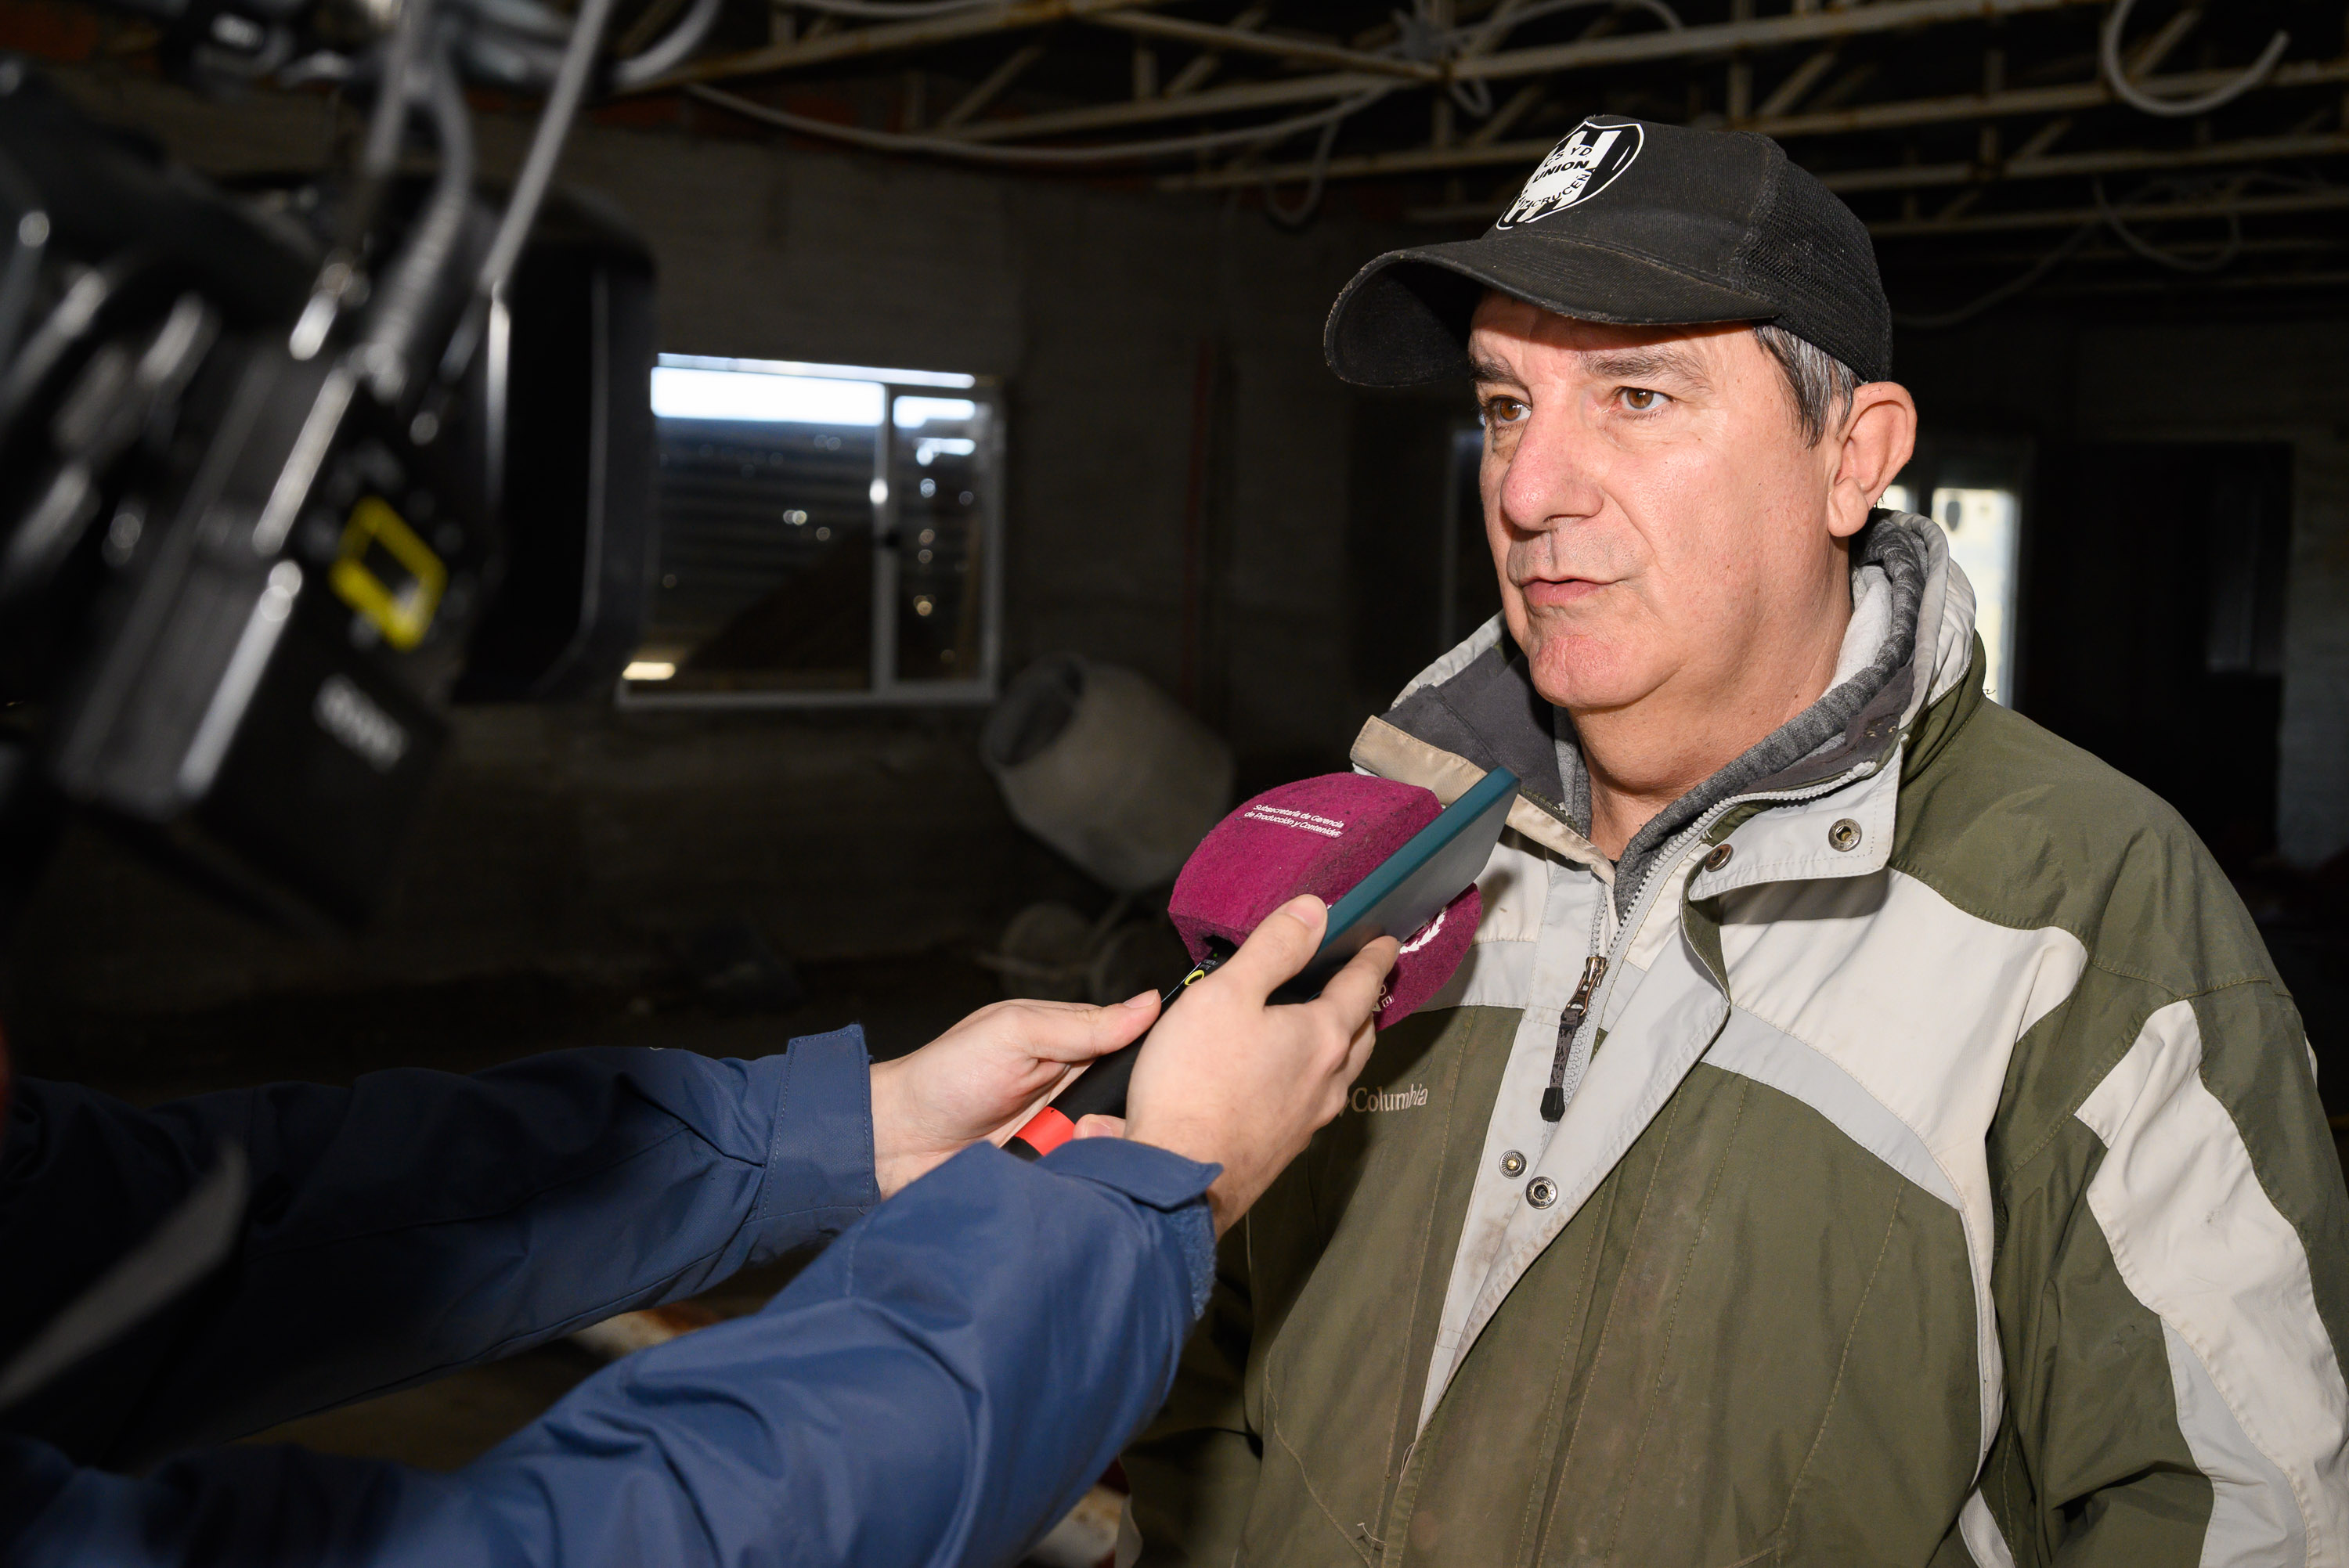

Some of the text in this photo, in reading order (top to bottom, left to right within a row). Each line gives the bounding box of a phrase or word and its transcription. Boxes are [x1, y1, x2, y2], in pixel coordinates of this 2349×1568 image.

[1570, 146, 1582, 156] Y
[1532, 160, 1590, 184] UNION
[1253, 804, 1344, 829] Subsecretaría de Gerencia
[1254, 813, 1294, 825] Producción
[1351, 1083, 1429, 1113] Columbia
